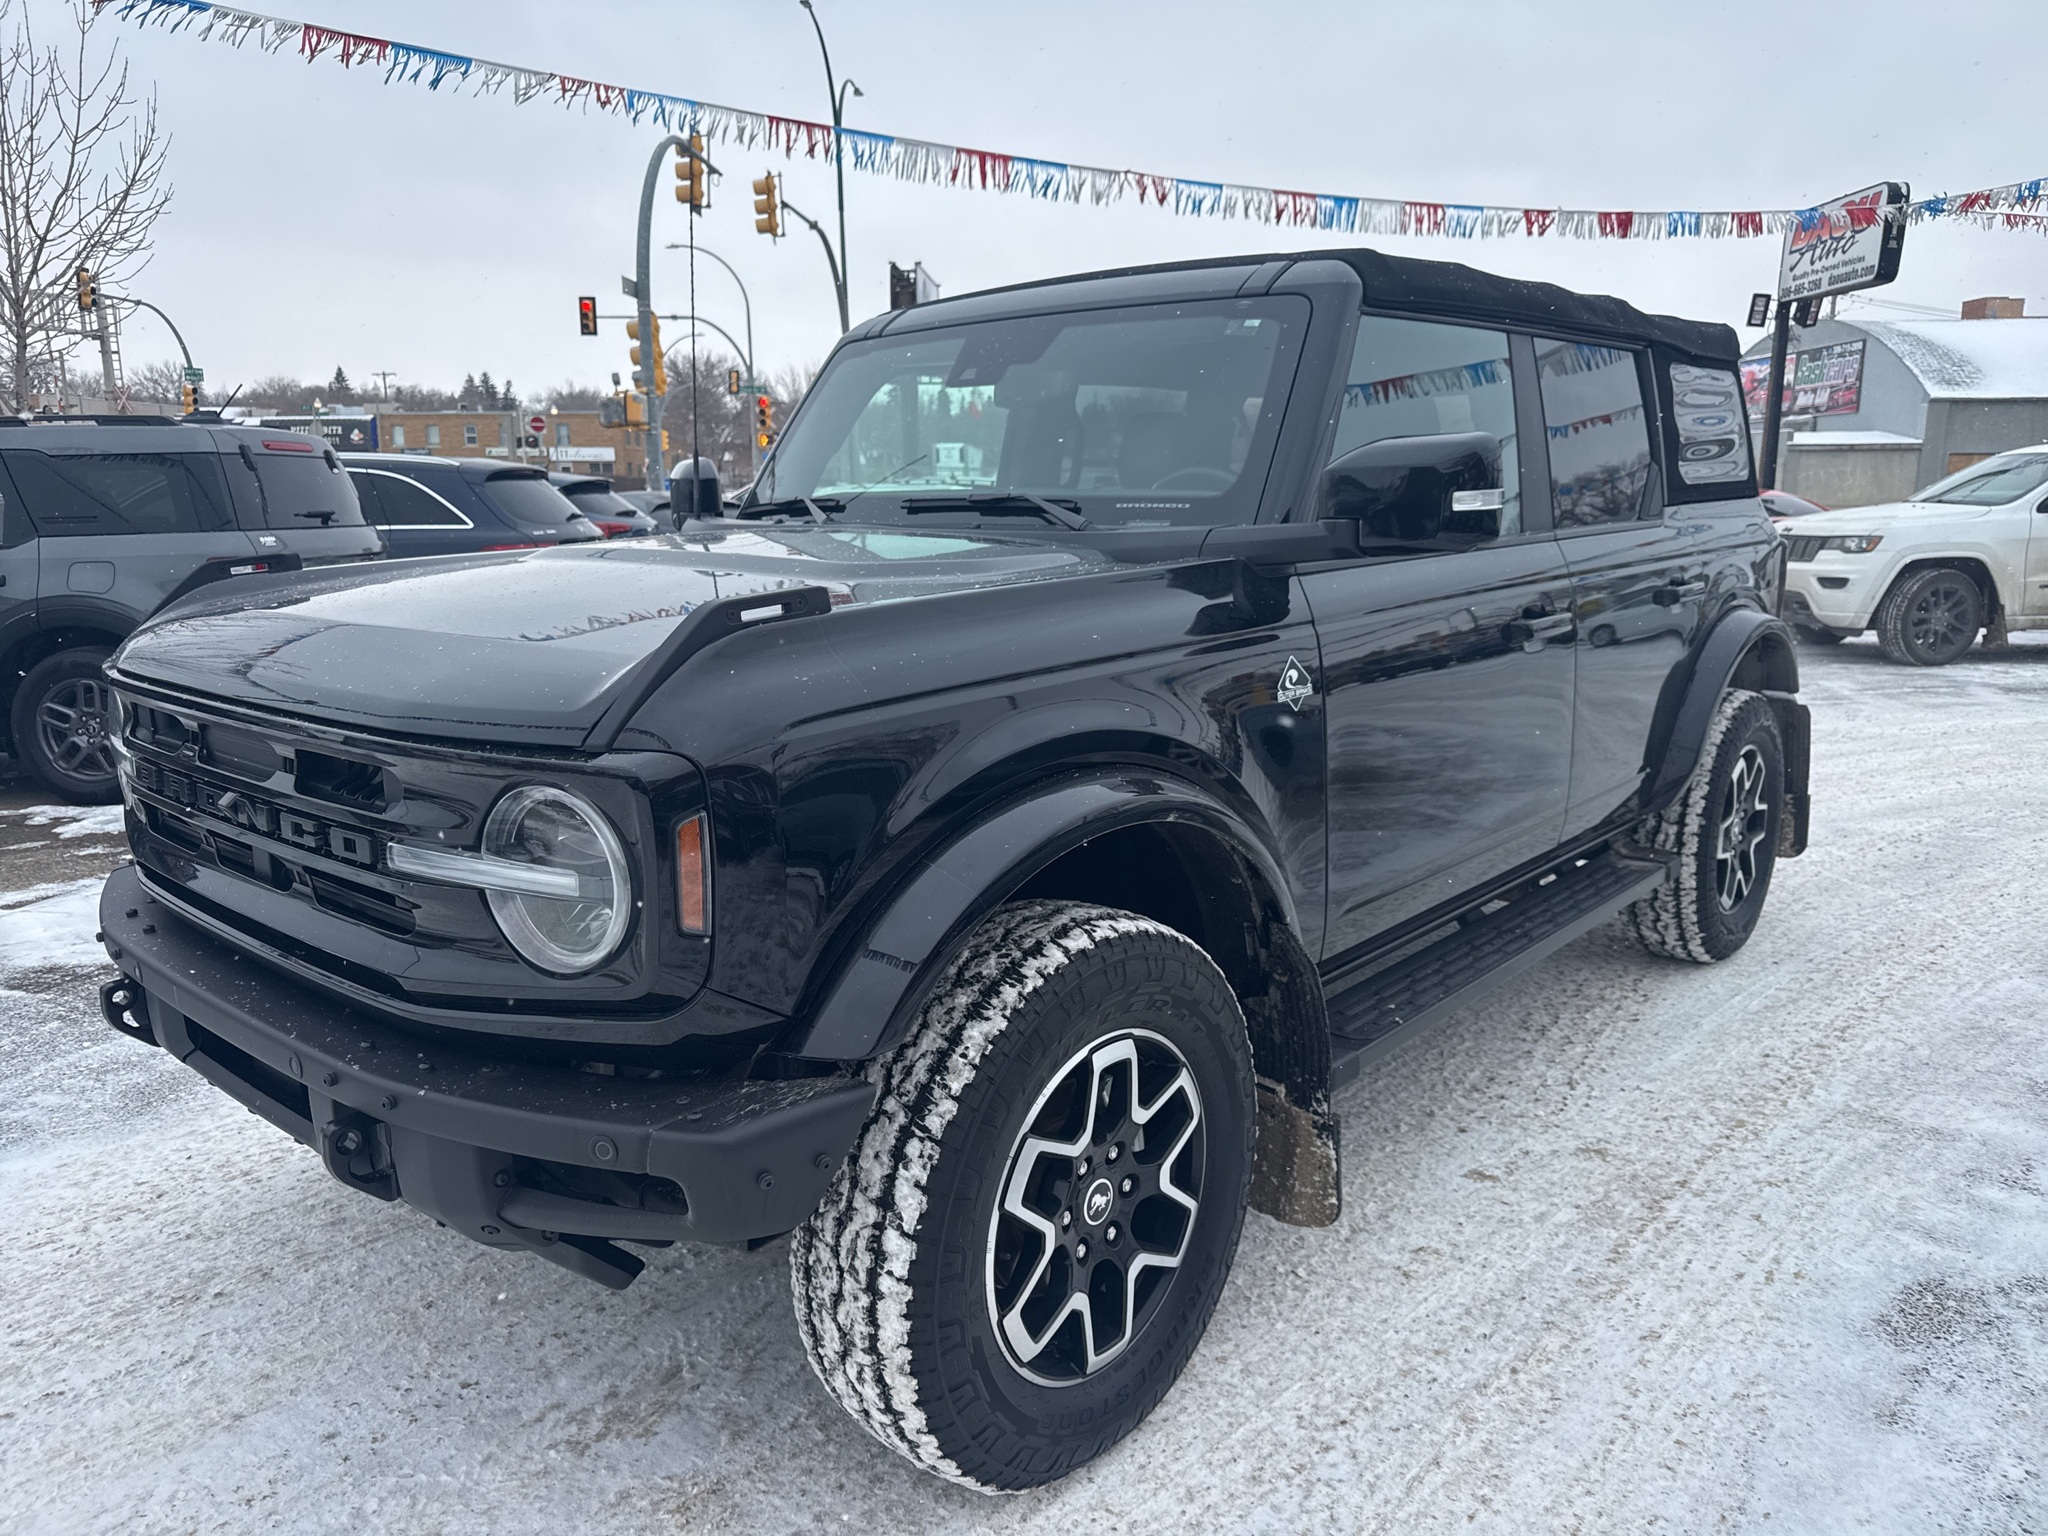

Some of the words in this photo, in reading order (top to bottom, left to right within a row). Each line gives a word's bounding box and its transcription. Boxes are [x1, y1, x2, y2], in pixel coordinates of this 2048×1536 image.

[1789, 233, 1860, 272] Auto
[1810, 260, 1841, 276] Pre-Owned
[1841, 255, 1866, 267] Vehicles
[1279, 691, 1295, 702] OUTER
[1295, 687, 1312, 697] BANKS
[136, 760, 378, 866] BRONCO
